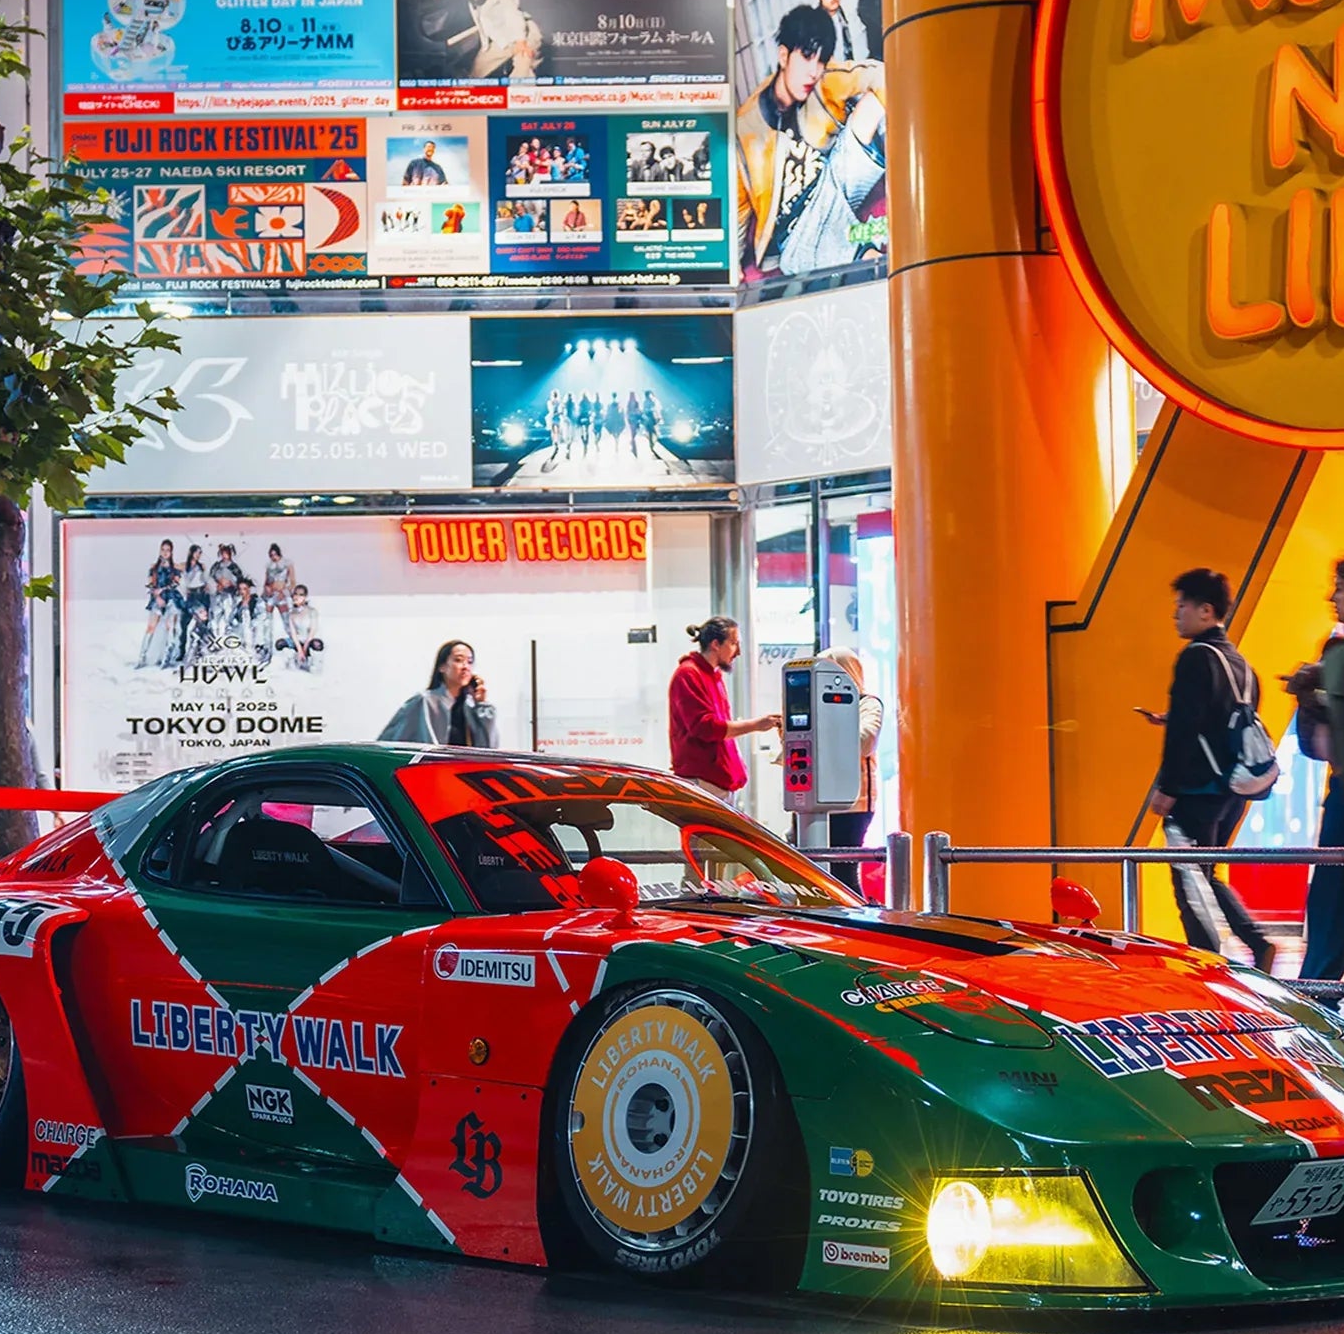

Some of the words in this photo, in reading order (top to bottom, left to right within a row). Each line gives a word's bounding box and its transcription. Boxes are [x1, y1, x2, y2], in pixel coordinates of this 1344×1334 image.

[240, 18, 282, 33] 8.10
[302, 18, 316, 32] 11
[226, 34, 354, 51] ぴあアリーナMM
[521, 122, 538, 131] SAT
[642, 120, 661, 129] SUN
[663, 120, 684, 129] JULY
[104, 128, 152, 153] FUJI
[159, 127, 217, 152] ROCK
[111, 167, 152, 178] 25-27
[159, 166, 213, 177] NAEBA
[216, 166, 241, 177] SKI
[244, 164, 306, 176] RESORT
[142, 281, 163, 290] info.
[165, 280, 189, 290] FUJI
[190, 280, 219, 289] ROCK
[285, 278, 379, 290] fujirockfestival.com
[269, 442, 388, 460] 2025.05.14
[397, 441, 448, 459] WED
[401, 517, 507, 563] TOWER
[513, 517, 648, 562] RECORDS
[207, 635, 242, 650] XG
[170, 702, 204, 712] MAY
[210, 702, 231, 713] 14,
[236, 702, 278, 712] 2025
[126, 717, 226, 735] TOKYO
[236, 716, 323, 734] DOME
[178, 739, 225, 748] TOKYO,
[229, 738, 271, 747] JAPAN
[460, 957, 532, 983] IDEMITSU
[840, 979, 946, 1007] CHARGE
[131, 999, 289, 1063] LIBERTY
[292, 1015, 407, 1078] WALK
[1053, 1010, 1259, 1079] LIBERTY
[591, 1020, 668, 1089] LIBERTY
[671, 1023, 718, 1083] WALK
[617, 1057, 684, 1091] ROHANA
[248, 1089, 293, 1116] NGK
[252, 1112, 271, 1121] SPARK
[272, 1114, 293, 1124] PLUGS
[35, 1118, 97, 1149] CHARGE
[617, 1146, 686, 1179] ROHANA
[187, 1172, 279, 1203] ROHANA
[587, 1151, 632, 1213] WALK
[633, 1149, 714, 1218] LIBERTY
[819, 1189, 859, 1205] TOYO
[860, 1194, 905, 1210] TIRES
[818, 1215, 902, 1232] PROXES
[840, 1247, 888, 1264] brembo
